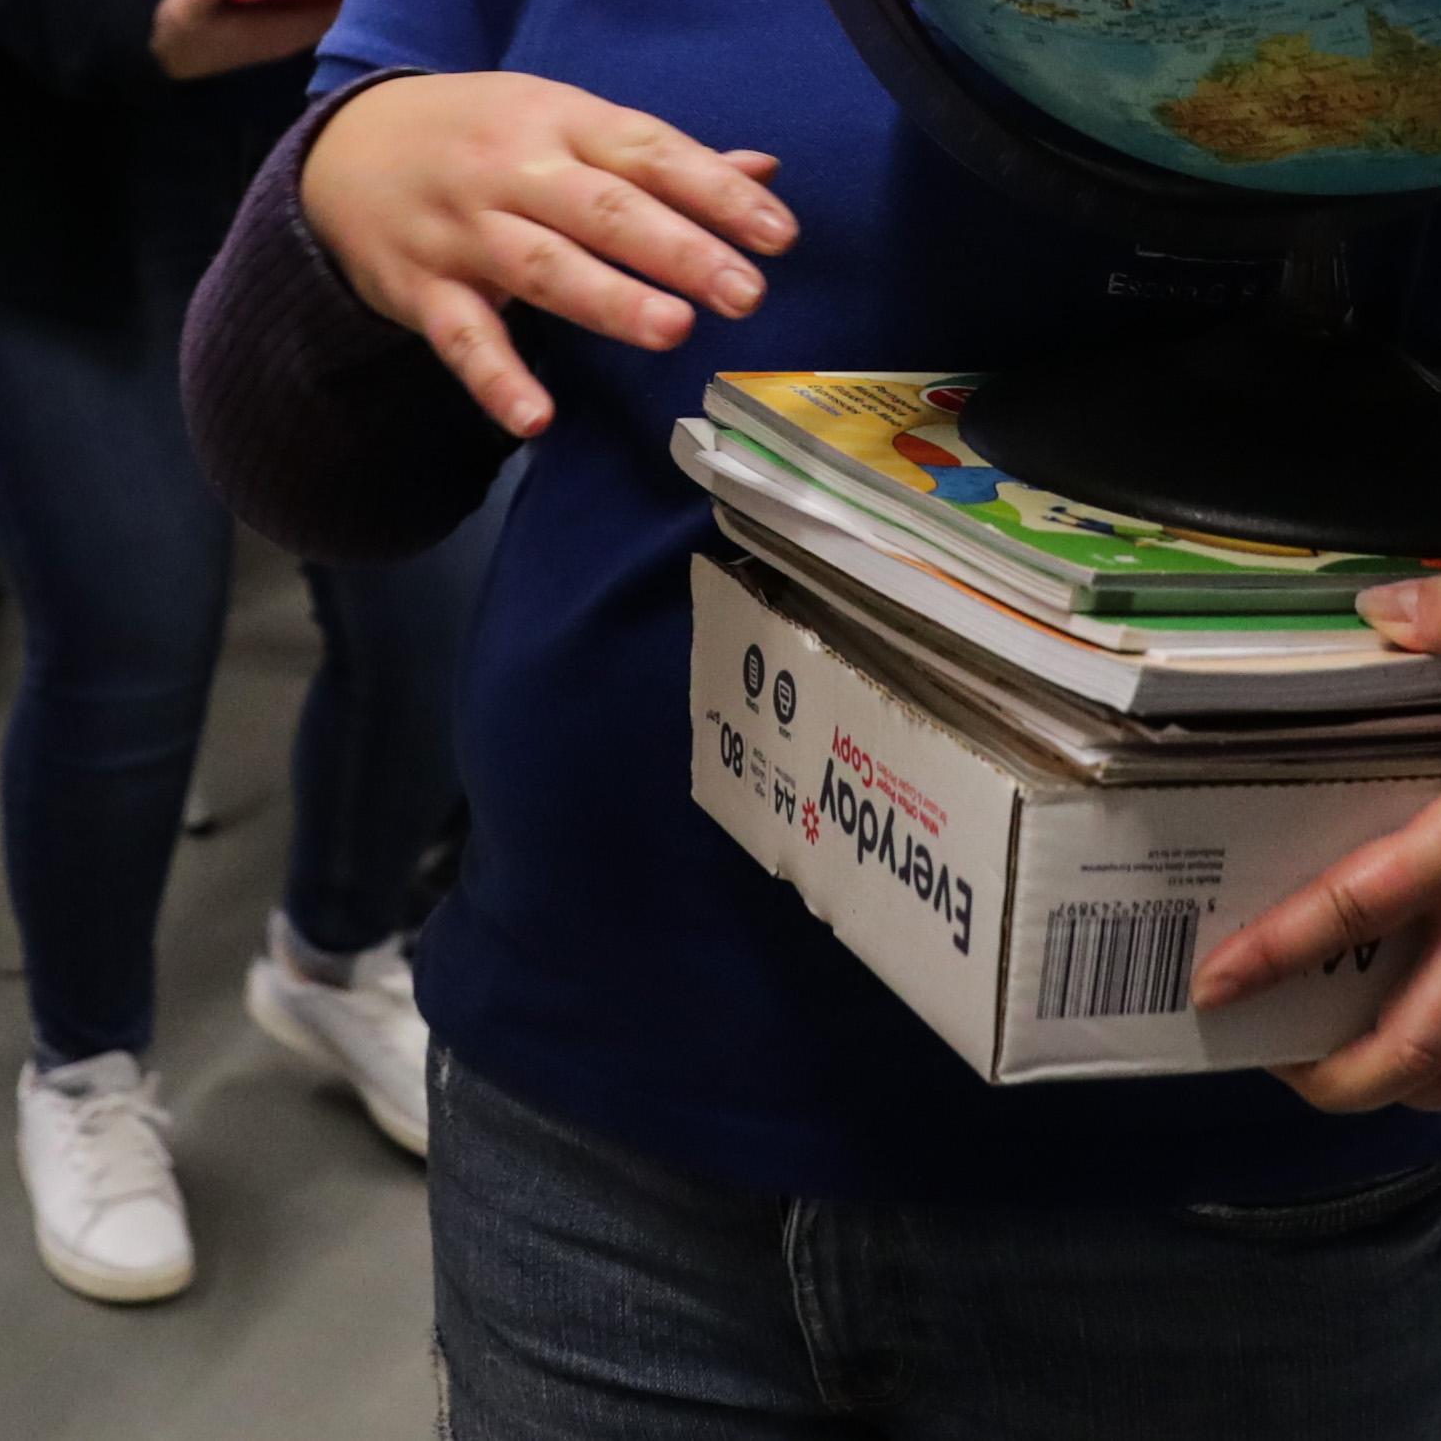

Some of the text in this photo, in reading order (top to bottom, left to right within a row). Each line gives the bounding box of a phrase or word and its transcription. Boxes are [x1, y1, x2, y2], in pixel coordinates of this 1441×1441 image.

[721, 722, 744, 778] 80
[832, 724, 874, 789] Copy
[774, 779, 797, 825] A4
[820, 757, 973, 956] Everyday
